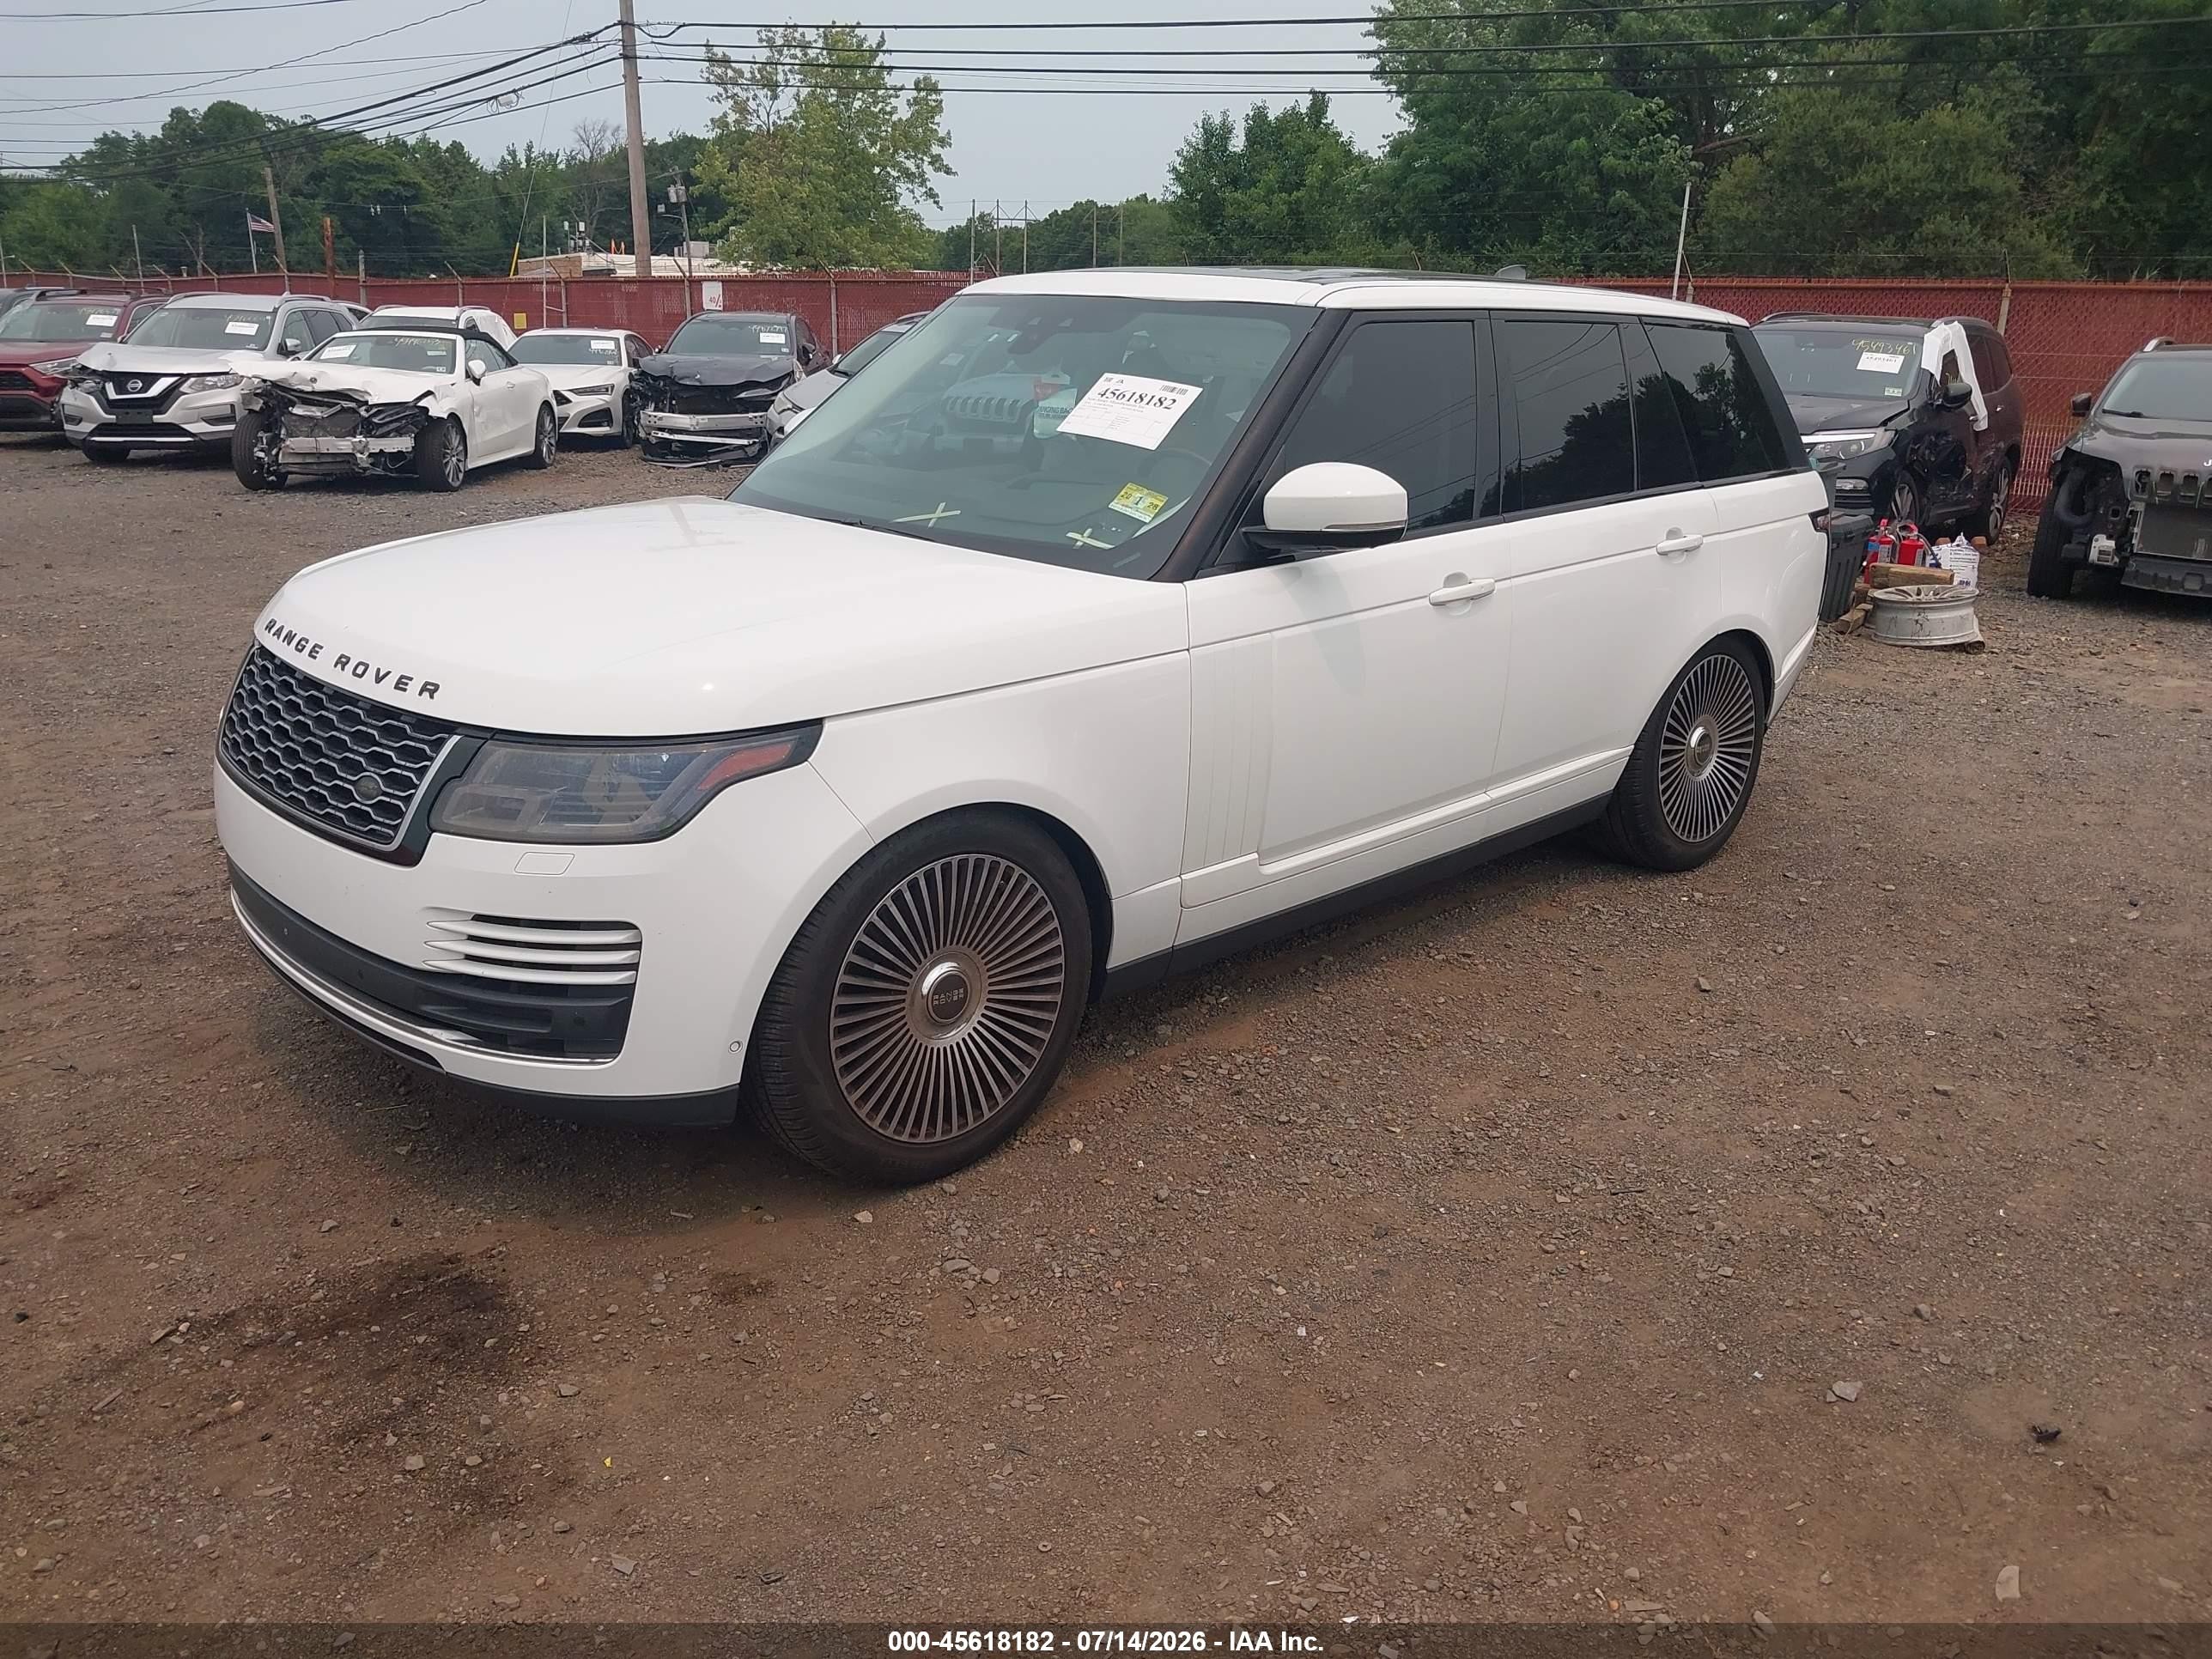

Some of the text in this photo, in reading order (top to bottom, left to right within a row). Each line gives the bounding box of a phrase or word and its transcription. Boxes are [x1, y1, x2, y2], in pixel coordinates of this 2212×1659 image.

[1851, 339, 1917, 355] 45493461
[1097, 387, 1178, 410] 45618182
[264, 618, 441, 700] RANGE ROVER
[933, 988, 964, 1006] RANGE ROVER
